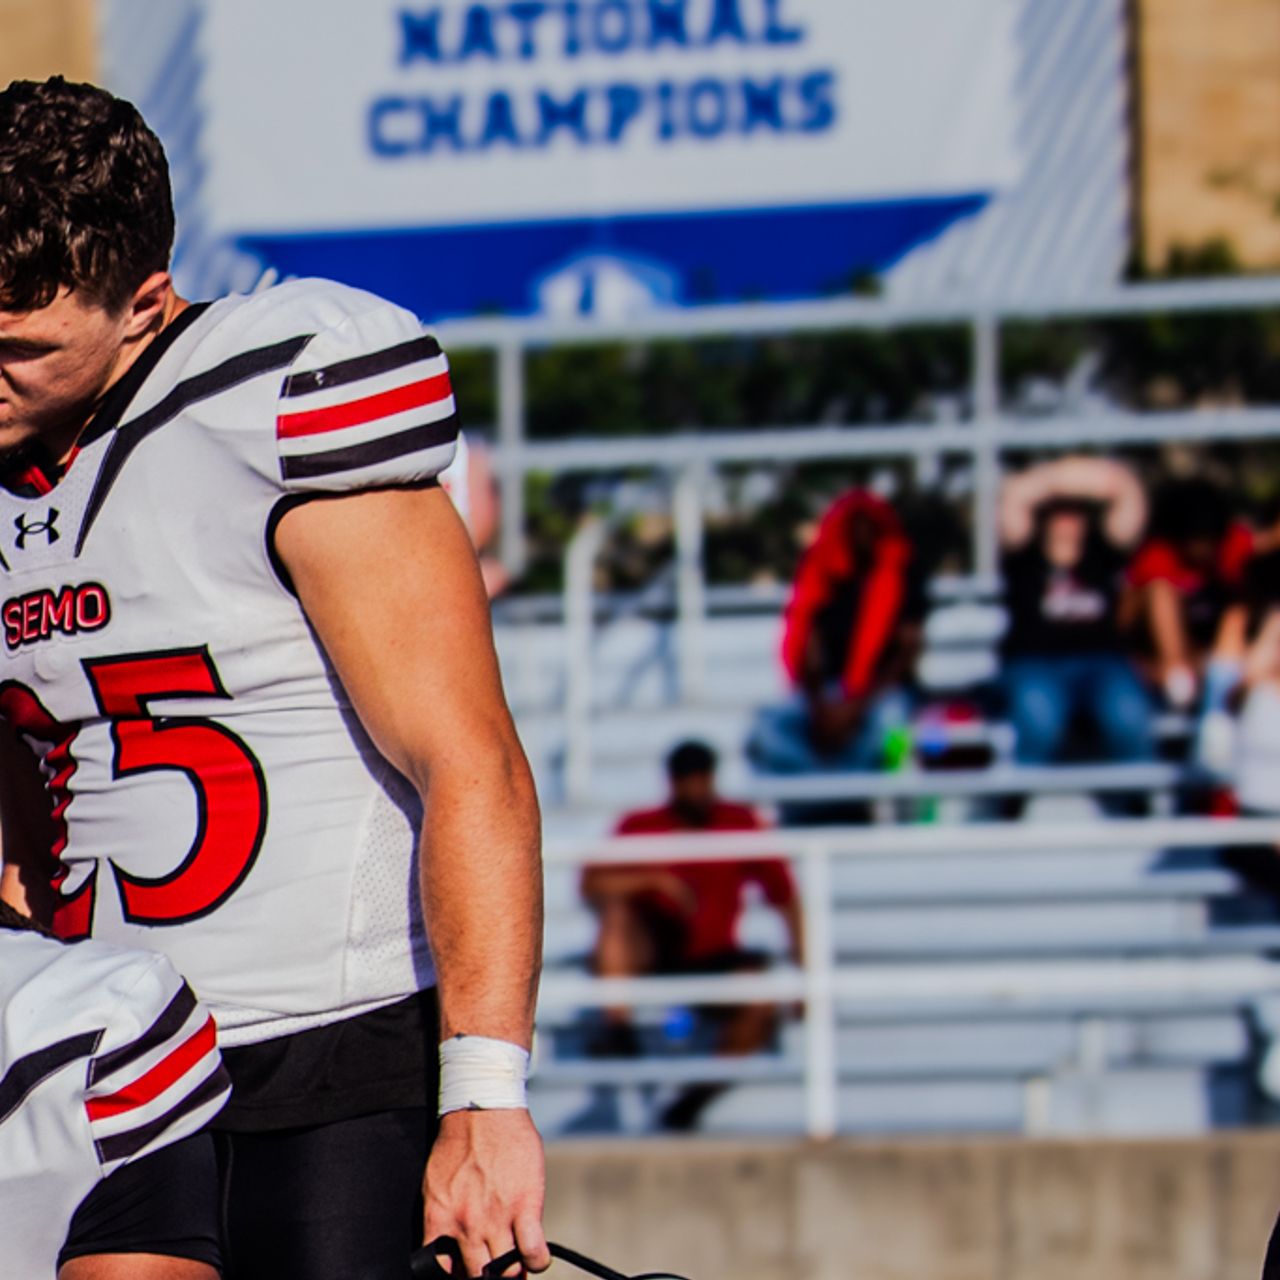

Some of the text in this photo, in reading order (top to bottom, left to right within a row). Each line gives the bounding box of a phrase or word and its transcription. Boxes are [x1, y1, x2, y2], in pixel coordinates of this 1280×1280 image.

[397, 0, 806, 66] NATIONAL
[368, 67, 837, 158] CHAMPIONS
[2, 581, 111, 651] SEMO
